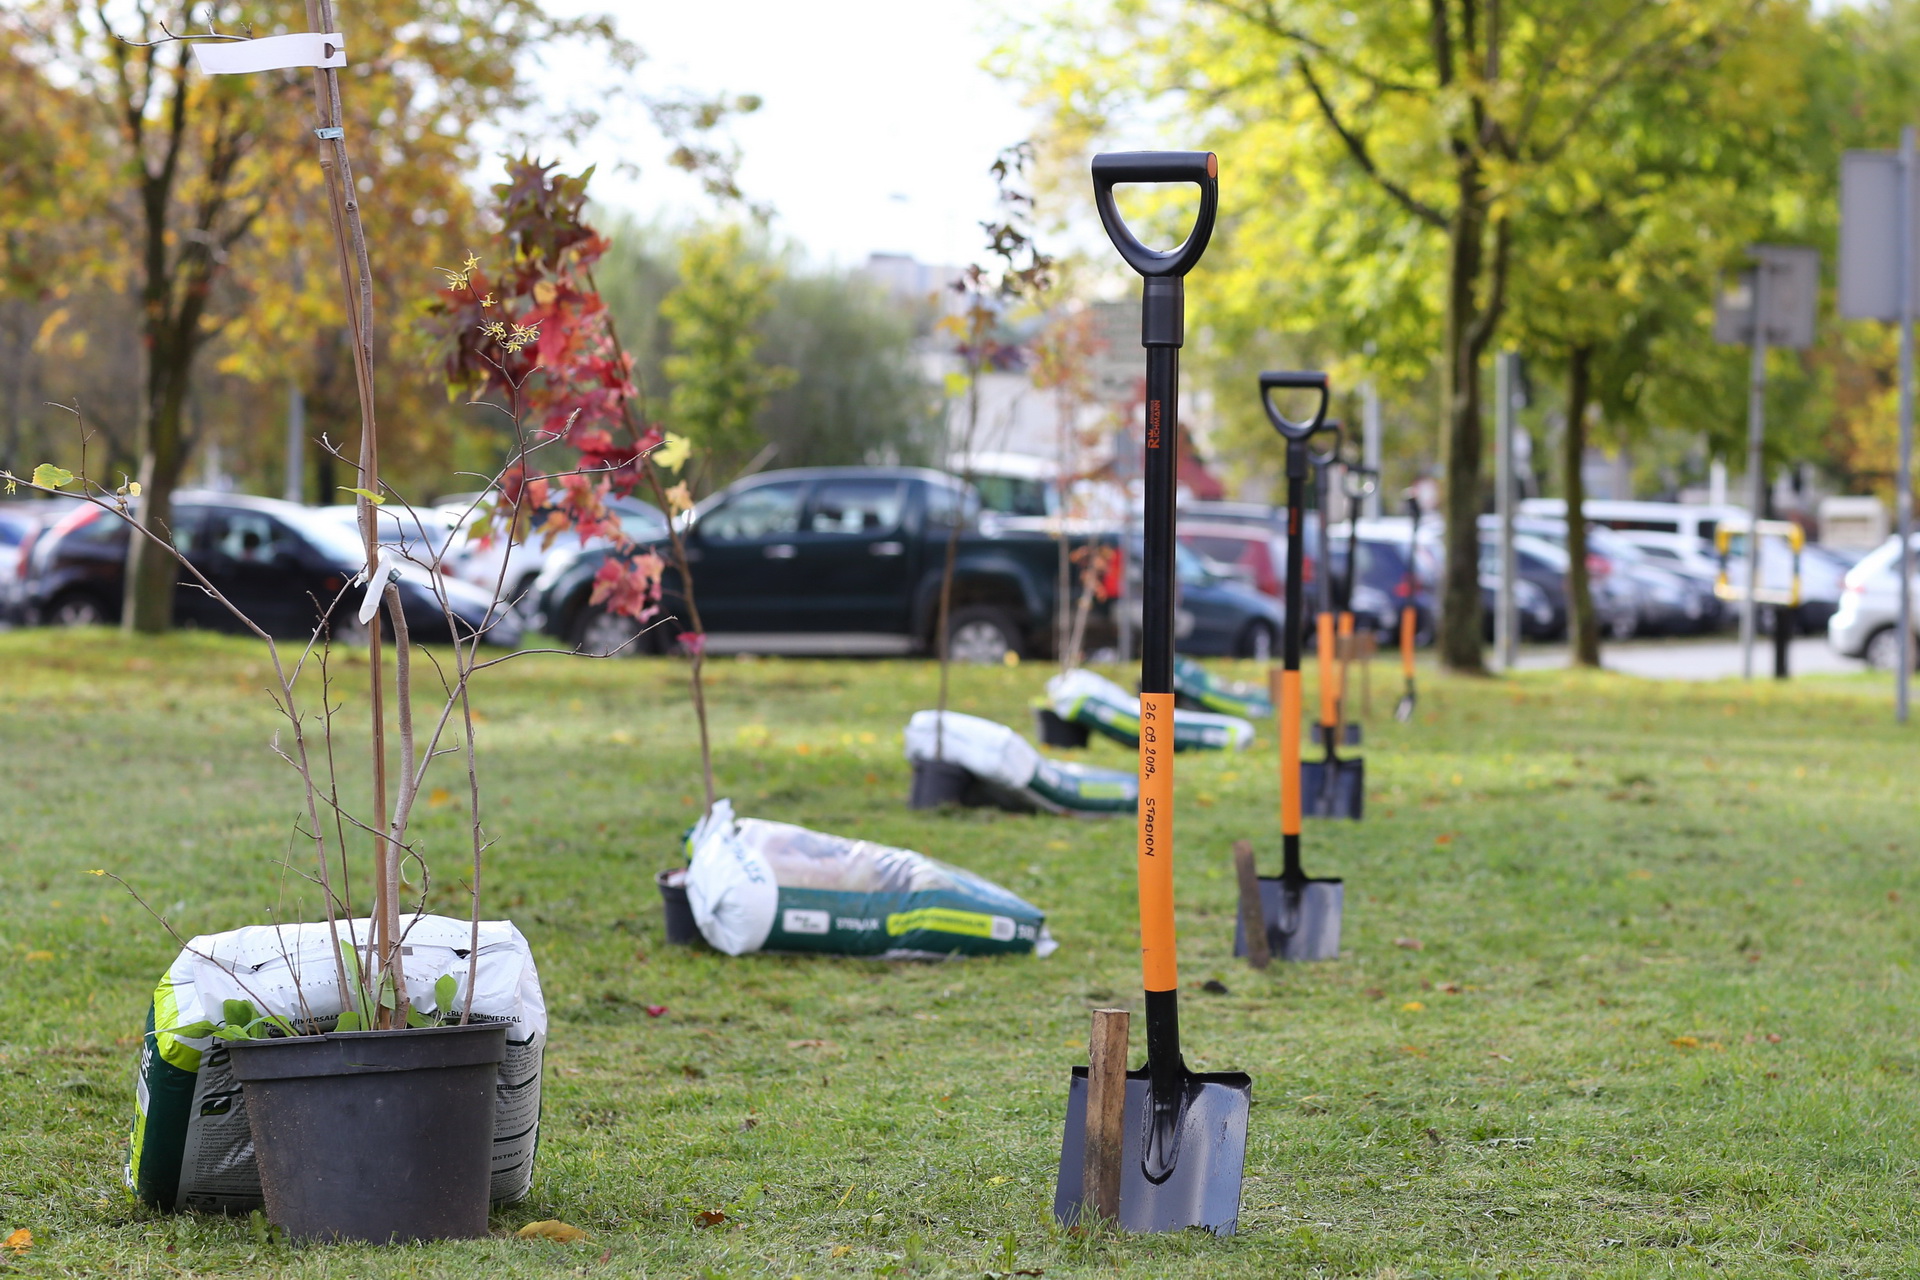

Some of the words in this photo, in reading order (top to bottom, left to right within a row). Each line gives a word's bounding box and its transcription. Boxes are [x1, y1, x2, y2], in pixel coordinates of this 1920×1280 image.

[1147, 399, 1160, 448] RICHMANN
[1145, 797, 1155, 857] STADION
[492, 1149, 523, 1161] BSTRAT
